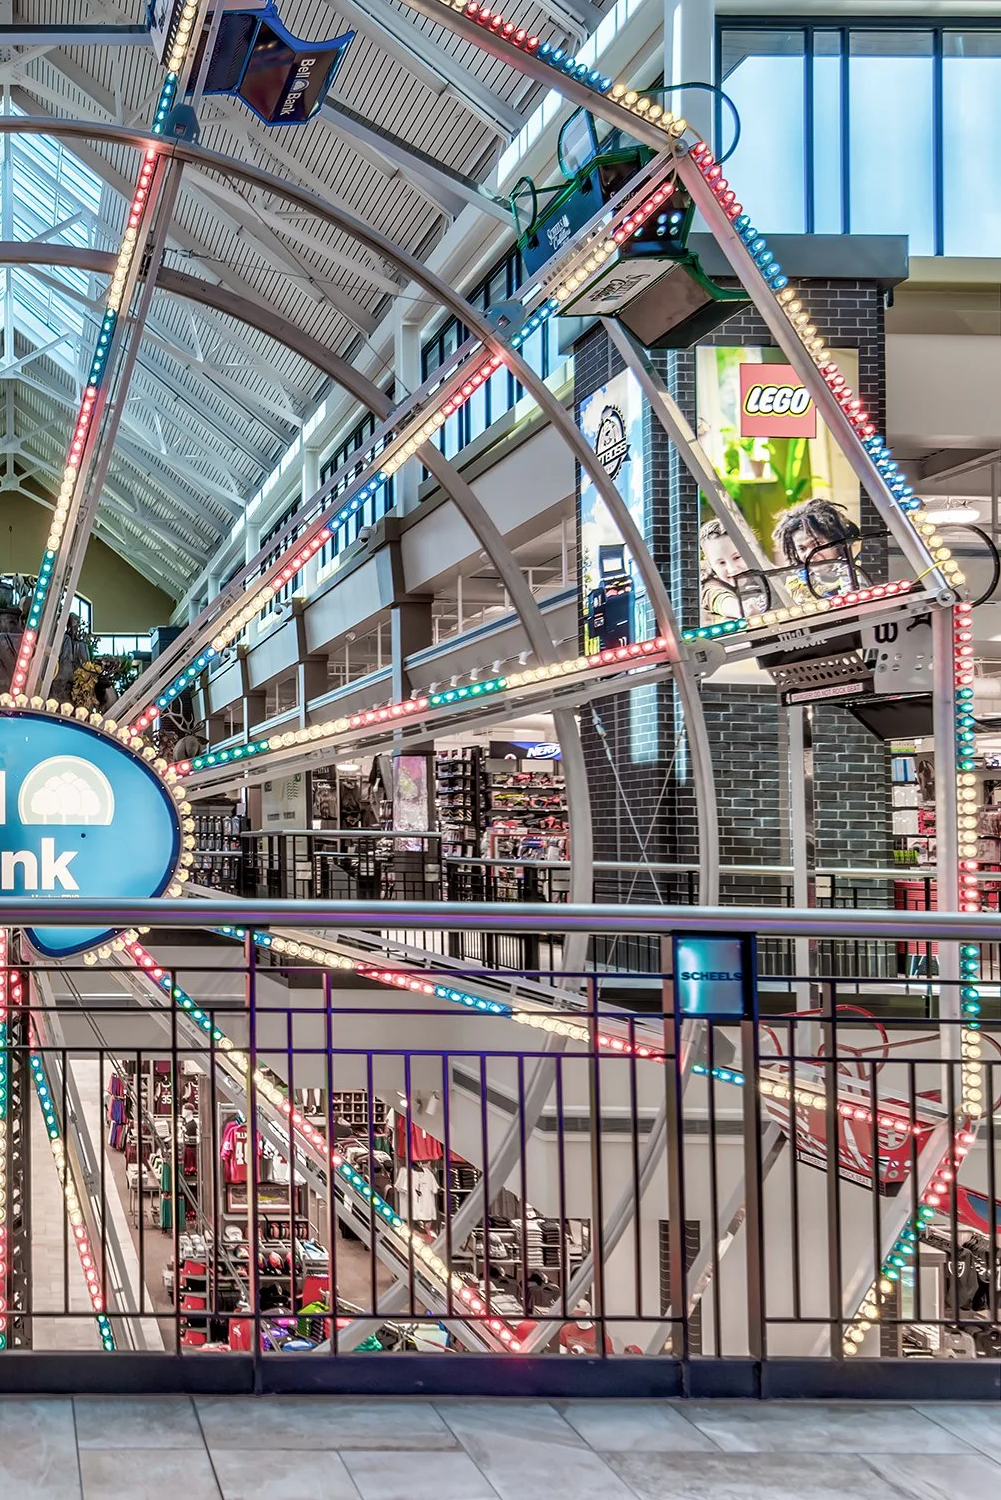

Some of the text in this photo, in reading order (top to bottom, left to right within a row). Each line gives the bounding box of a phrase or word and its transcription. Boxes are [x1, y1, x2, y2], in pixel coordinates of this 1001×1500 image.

[279, 58, 316, 116] Bell Bank
[746, 385, 813, 415] LEGO
[680, 971, 743, 982] SCHEELS
[161, 1094, 172, 1105] 35
